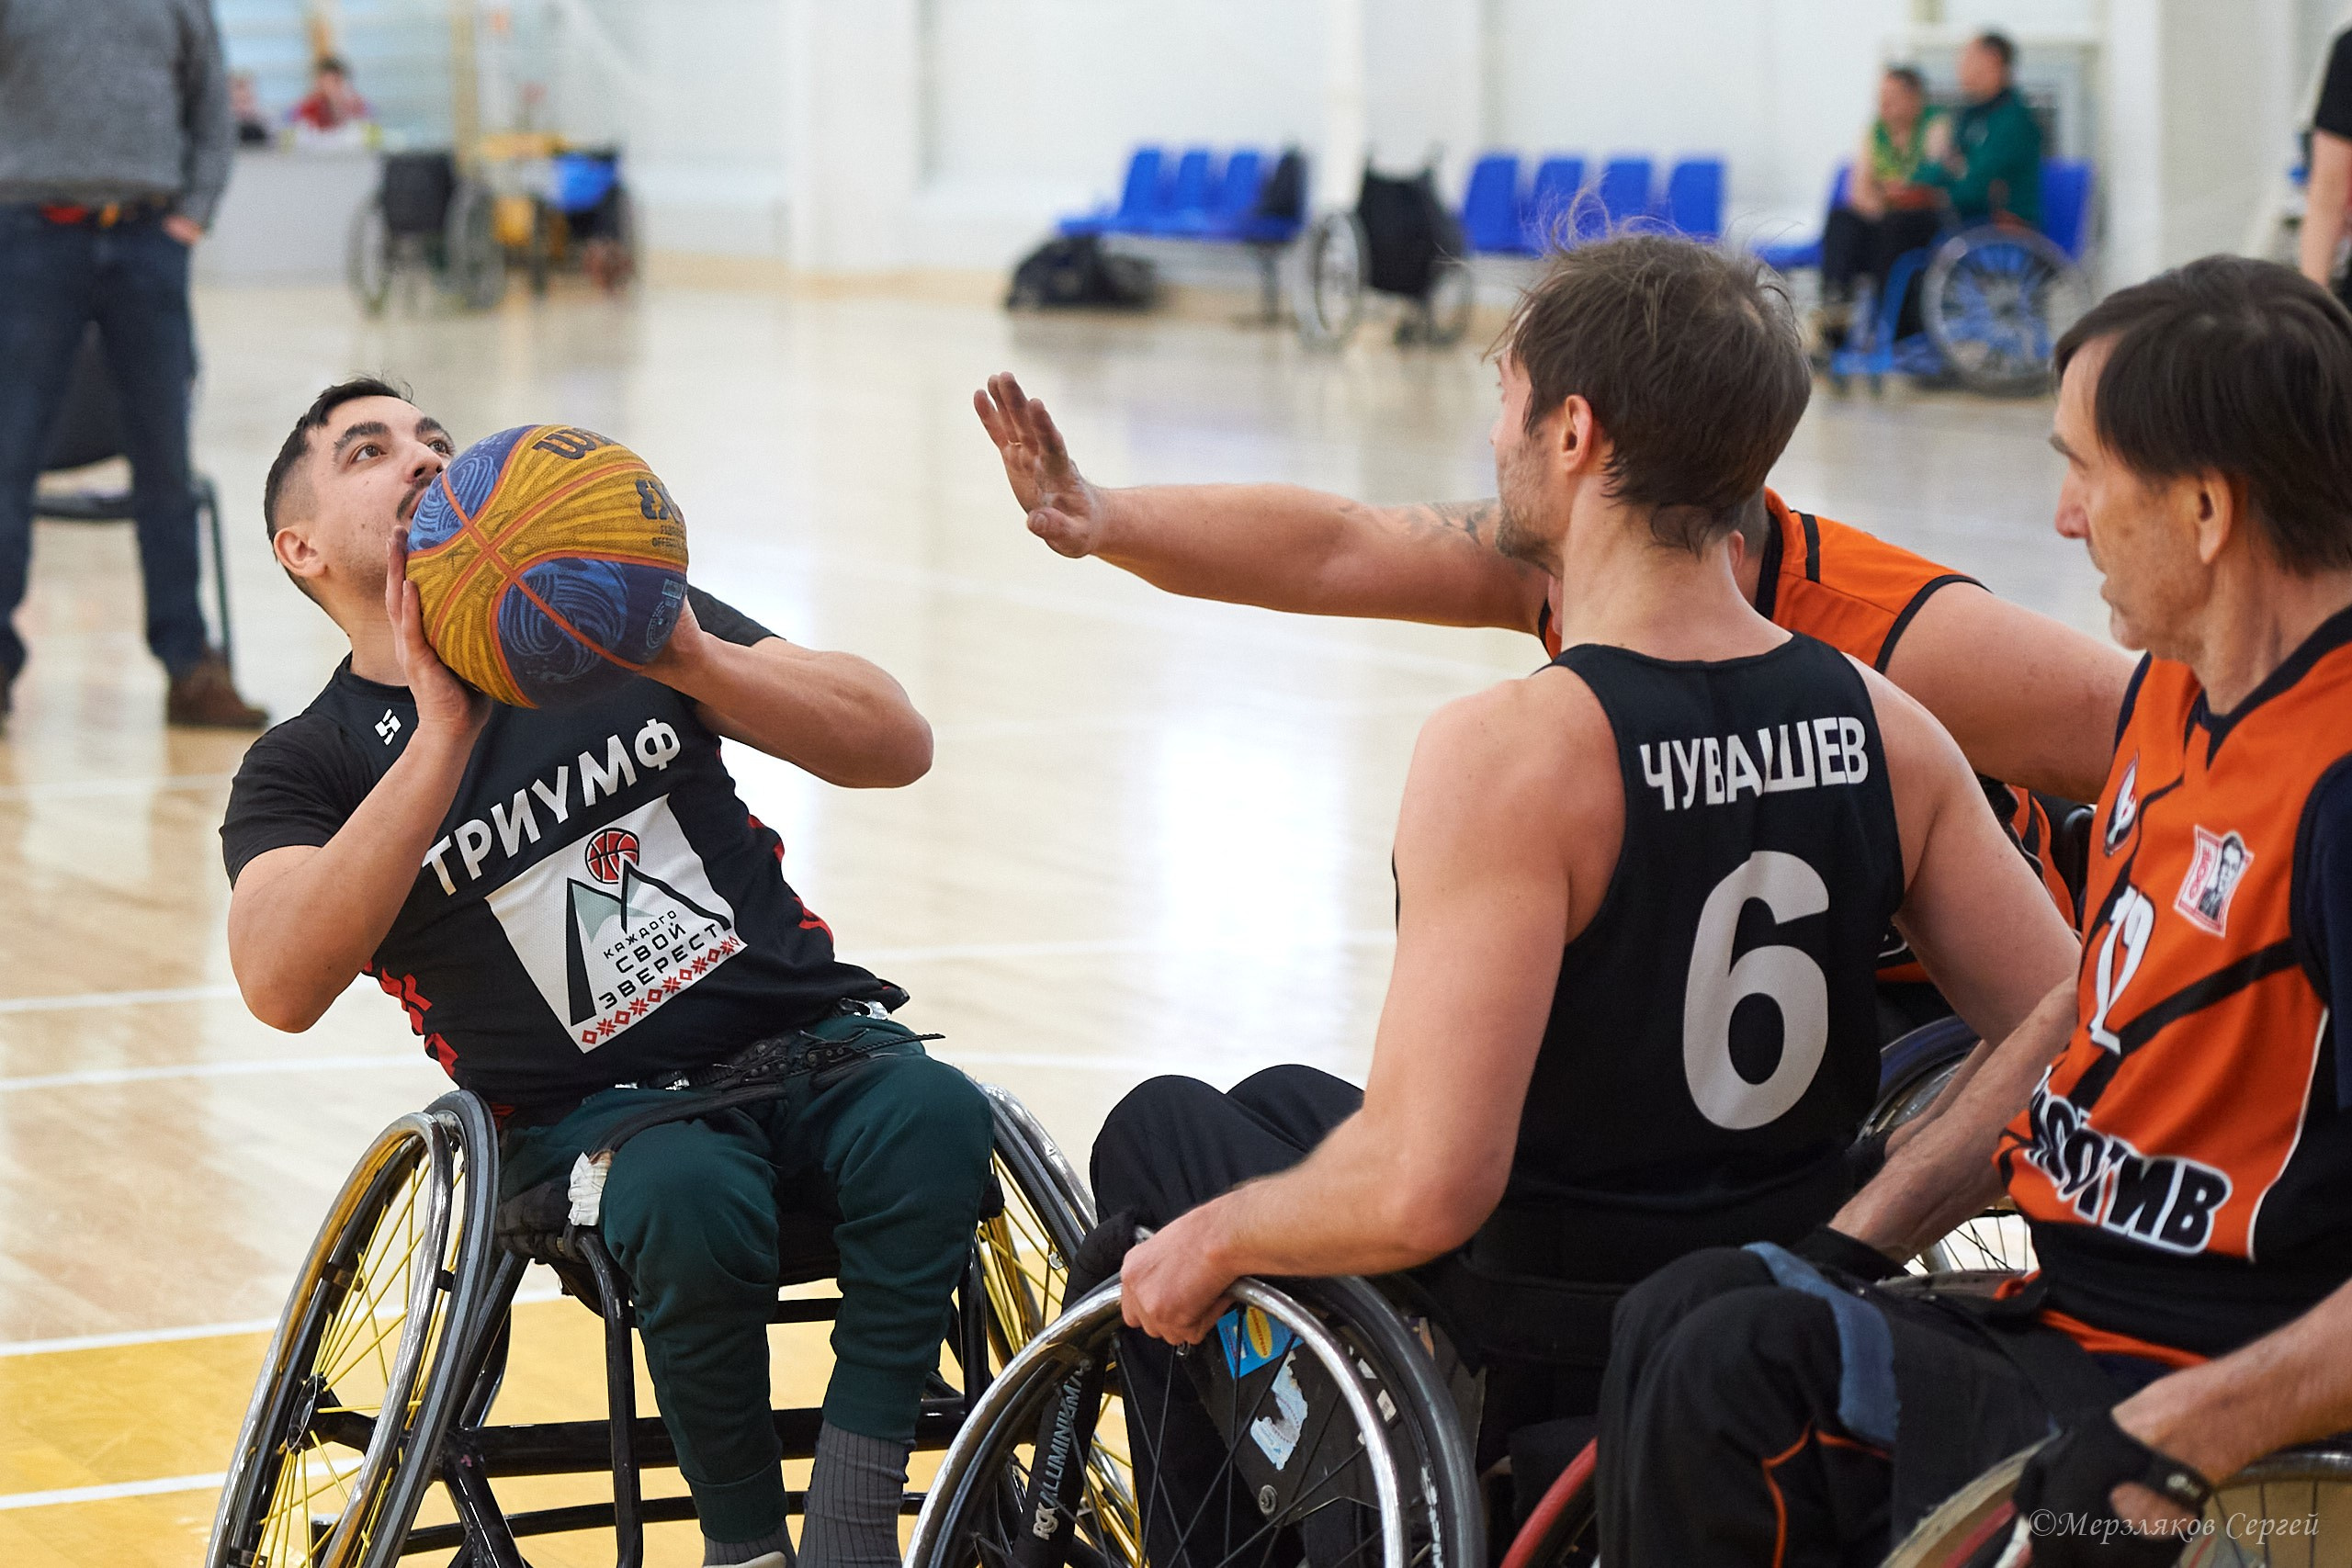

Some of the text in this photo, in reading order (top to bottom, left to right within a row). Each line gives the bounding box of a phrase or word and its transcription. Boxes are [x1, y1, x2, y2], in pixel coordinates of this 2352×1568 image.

[423, 718, 681, 896] ТРИУМФ
[1639, 716, 1869, 810] ЧУВАШЕВ
[598, 923, 718, 1010] ЭВЕРЕСТ
[616, 922, 686, 974] СВОЙ
[1683, 851, 1829, 1130] 6
